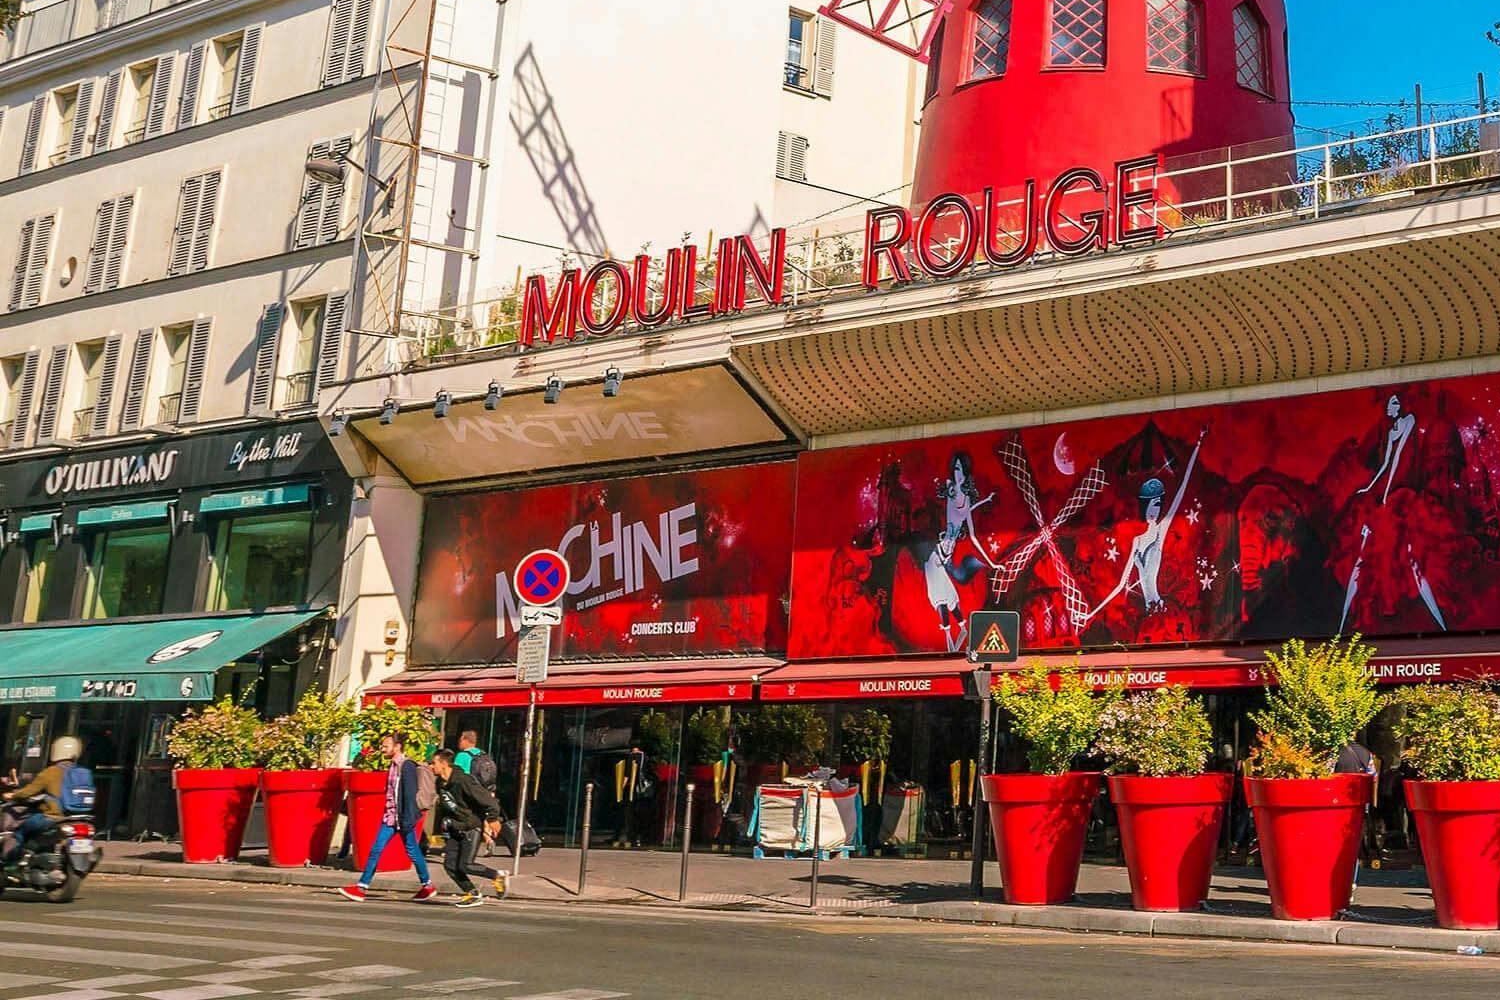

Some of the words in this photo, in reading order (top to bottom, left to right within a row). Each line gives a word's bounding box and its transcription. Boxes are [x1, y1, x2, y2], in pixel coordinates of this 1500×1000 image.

[518, 227, 787, 347] MOULIN
[862, 153, 1165, 291] ROUGE
[230, 441, 247, 470] By
[246, 438, 271, 462] the
[269, 432, 302, 459] Mill
[45, 450, 178, 496] O'SULLIVANS
[496, 502, 699, 640] MCHINE
[631, 622, 673, 635] CONCERTS
[674, 621, 696, 634] CLUB
[1396, 663, 1441, 677] ROUGE
[1127, 672, 1166, 684] ROUGE
[603, 689, 633, 699] MOULIN
[634, 687, 663, 698] ROUGE
[860, 681, 896, 692] MOULIN
[898, 680, 931, 691] ROUGE
[431, 694, 457, 704] MOULIN
[458, 692, 483, 703] ROUGE
